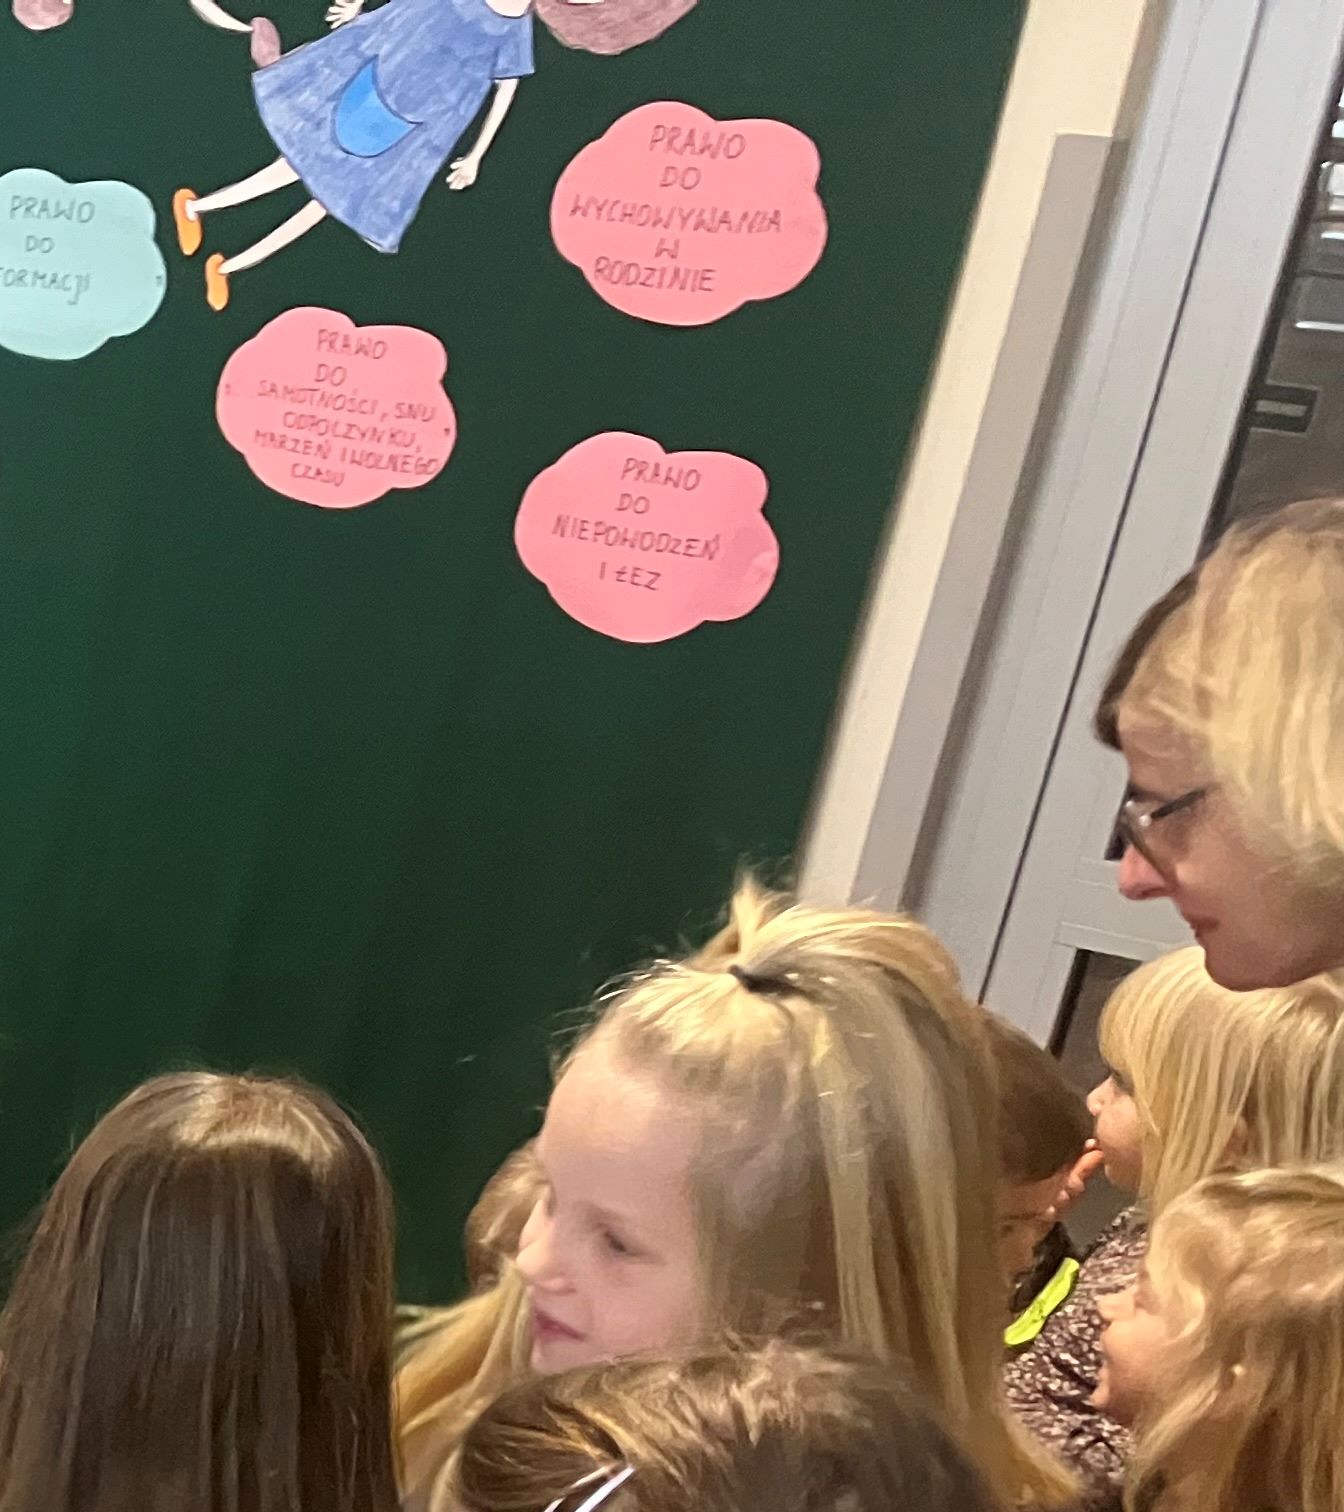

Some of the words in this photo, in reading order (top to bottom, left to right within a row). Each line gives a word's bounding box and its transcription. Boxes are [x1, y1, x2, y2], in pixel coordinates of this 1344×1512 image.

[649, 124, 747, 159] PRAWO
[659, 166, 701, 190] DO
[9, 195, 95, 223] PRAWO
[569, 194, 782, 233] WYCHOWYWANIA
[24, 235, 55, 253] DO
[655, 237, 680, 259] W
[593, 256, 716, 292] RODZINIE
[317, 328, 387, 359] PRAWO
[314, 363, 347, 387] DO
[291, 463, 346, 488] CZASU
[350, 449, 439, 475] WOLNEGO
[619, 457, 701, 491] PRAWO
[615, 492, 650, 515] DO
[599, 561, 606, 580] I
[615, 565, 662, 591] ŁEZ
